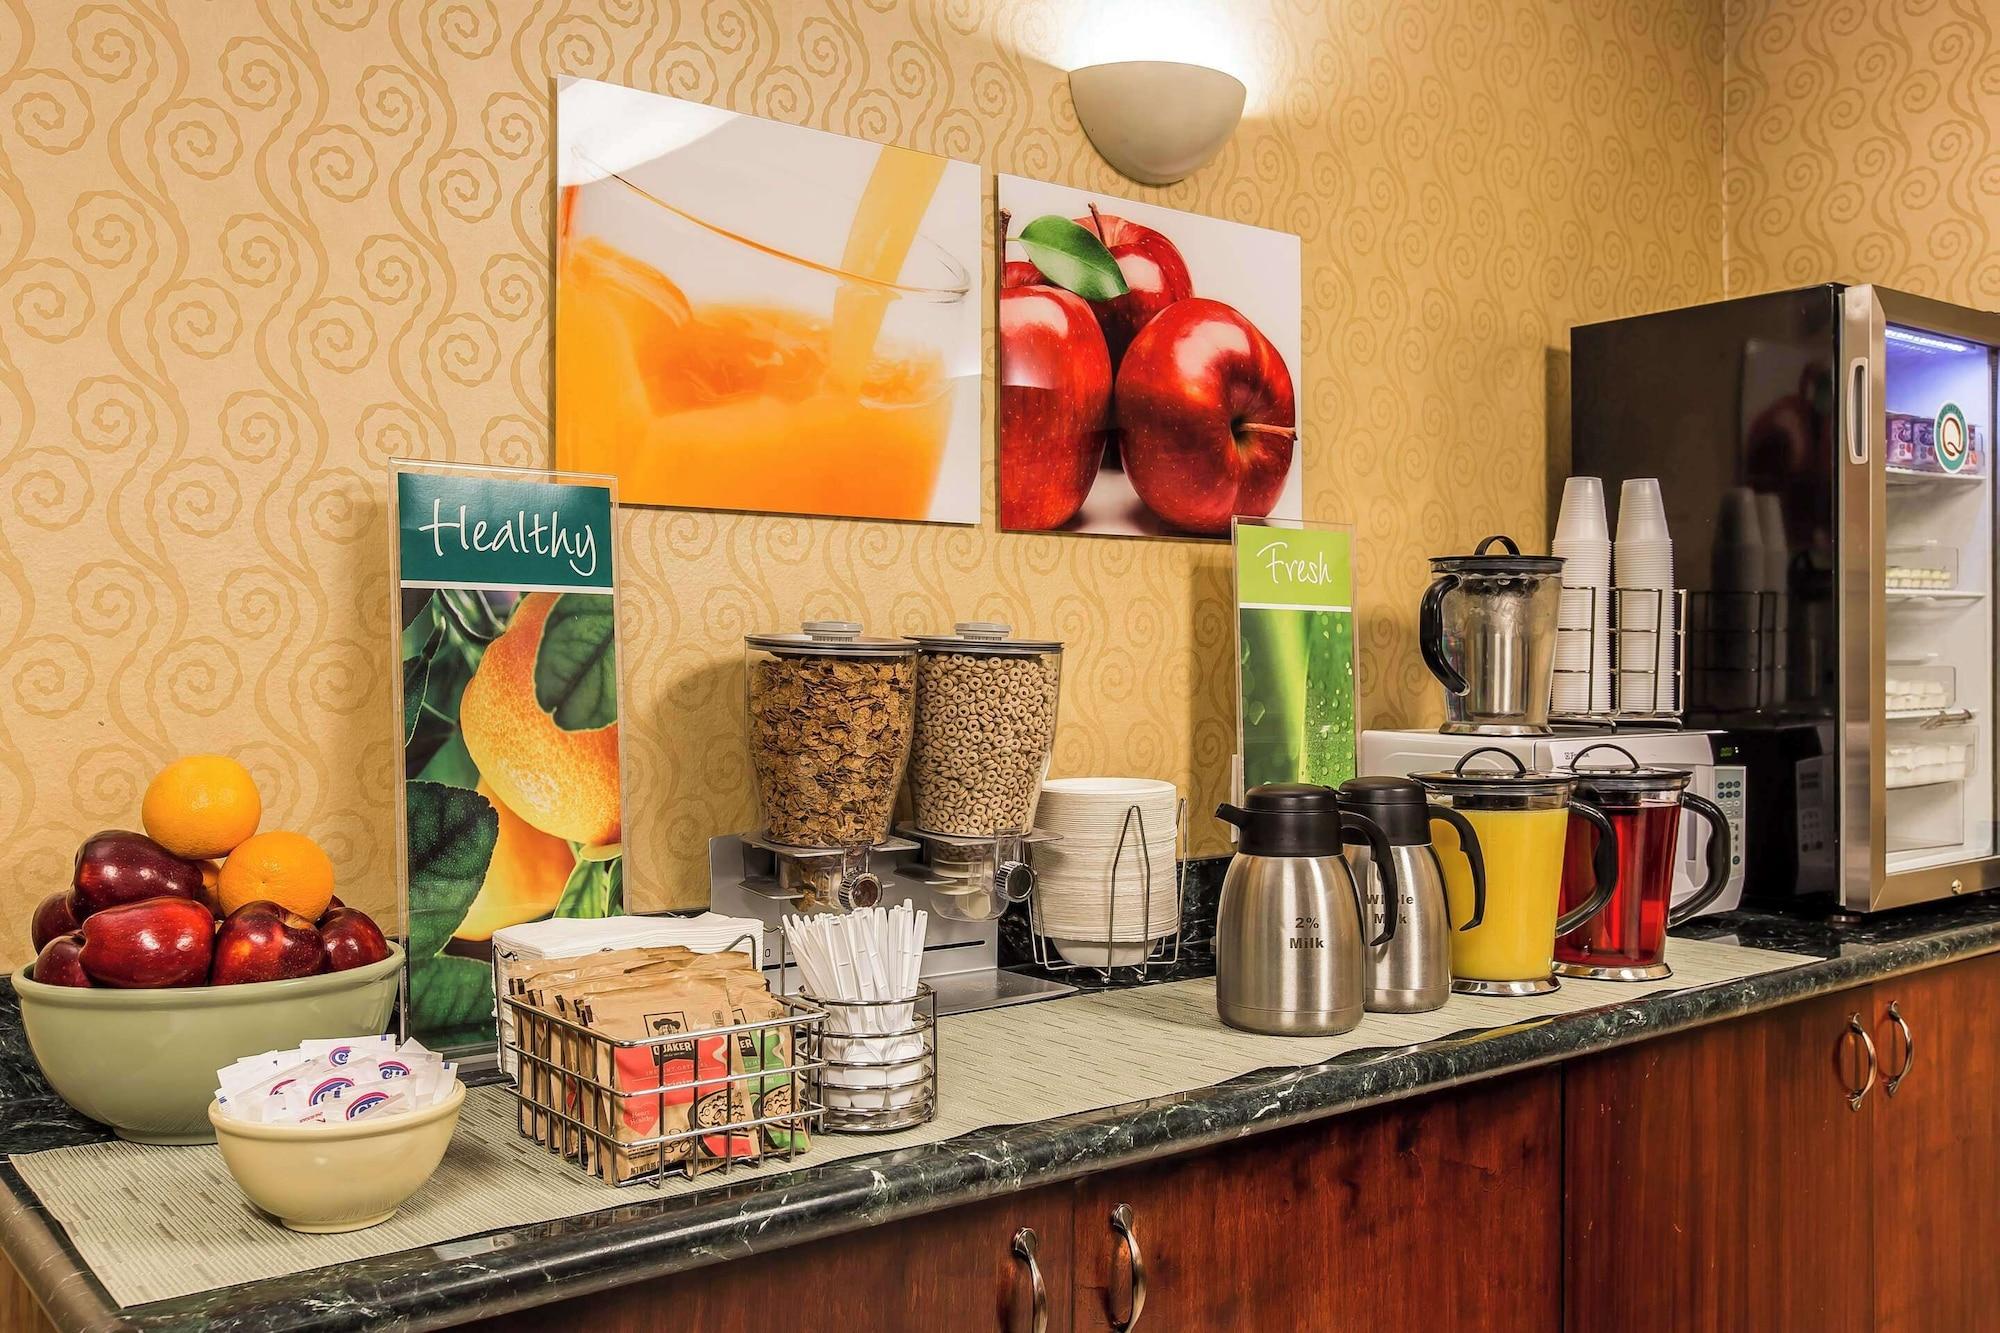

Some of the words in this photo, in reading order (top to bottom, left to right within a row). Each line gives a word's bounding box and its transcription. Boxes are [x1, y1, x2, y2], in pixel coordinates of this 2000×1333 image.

[418, 498, 597, 577] Healthy
[1256, 541, 1332, 586] Fresh
[1365, 894, 1414, 905] Wle
[1295, 917, 1319, 929] 2%
[1374, 913, 1407, 924] Mk
[1289, 937, 1324, 949] Milk
